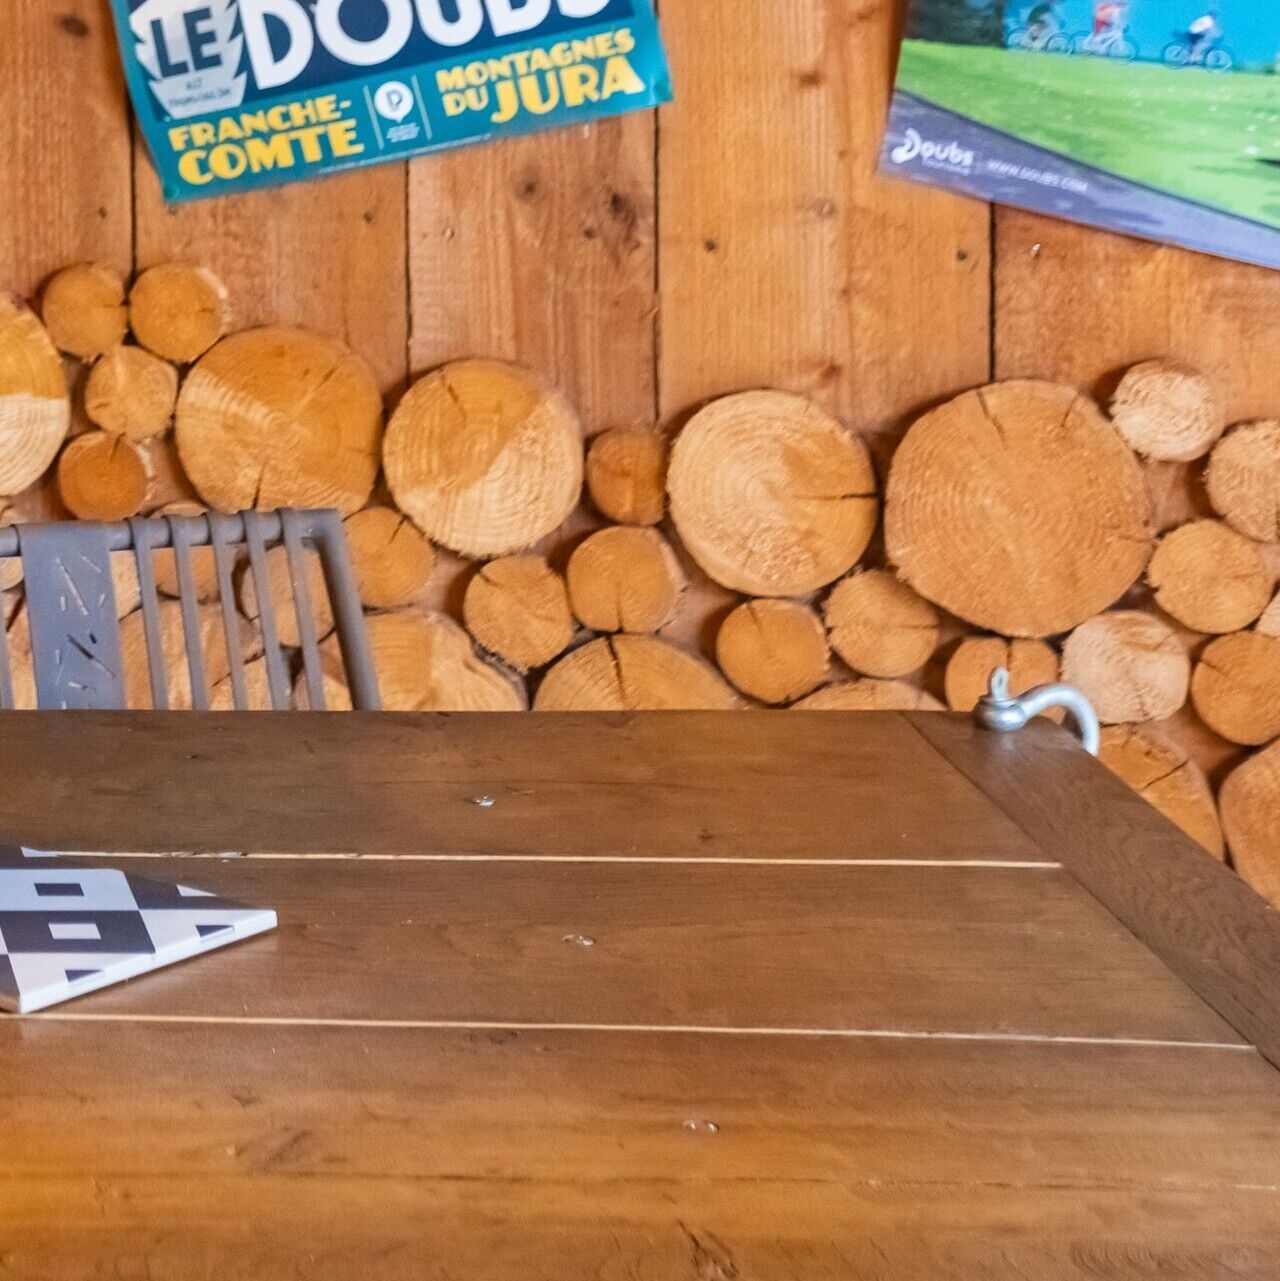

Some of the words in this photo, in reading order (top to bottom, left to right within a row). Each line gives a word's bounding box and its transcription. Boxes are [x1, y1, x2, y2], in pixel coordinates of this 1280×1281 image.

[149, 7, 221, 78] LE
[435, 26, 636, 96] MONTAGNES
[167, 94, 353, 152] FRANCHE-
[442, 85, 489, 118] DU
[490, 53, 647, 124] JURA
[178, 117, 365, 186] COMTE
[891, 127, 975, 167] Doubs
